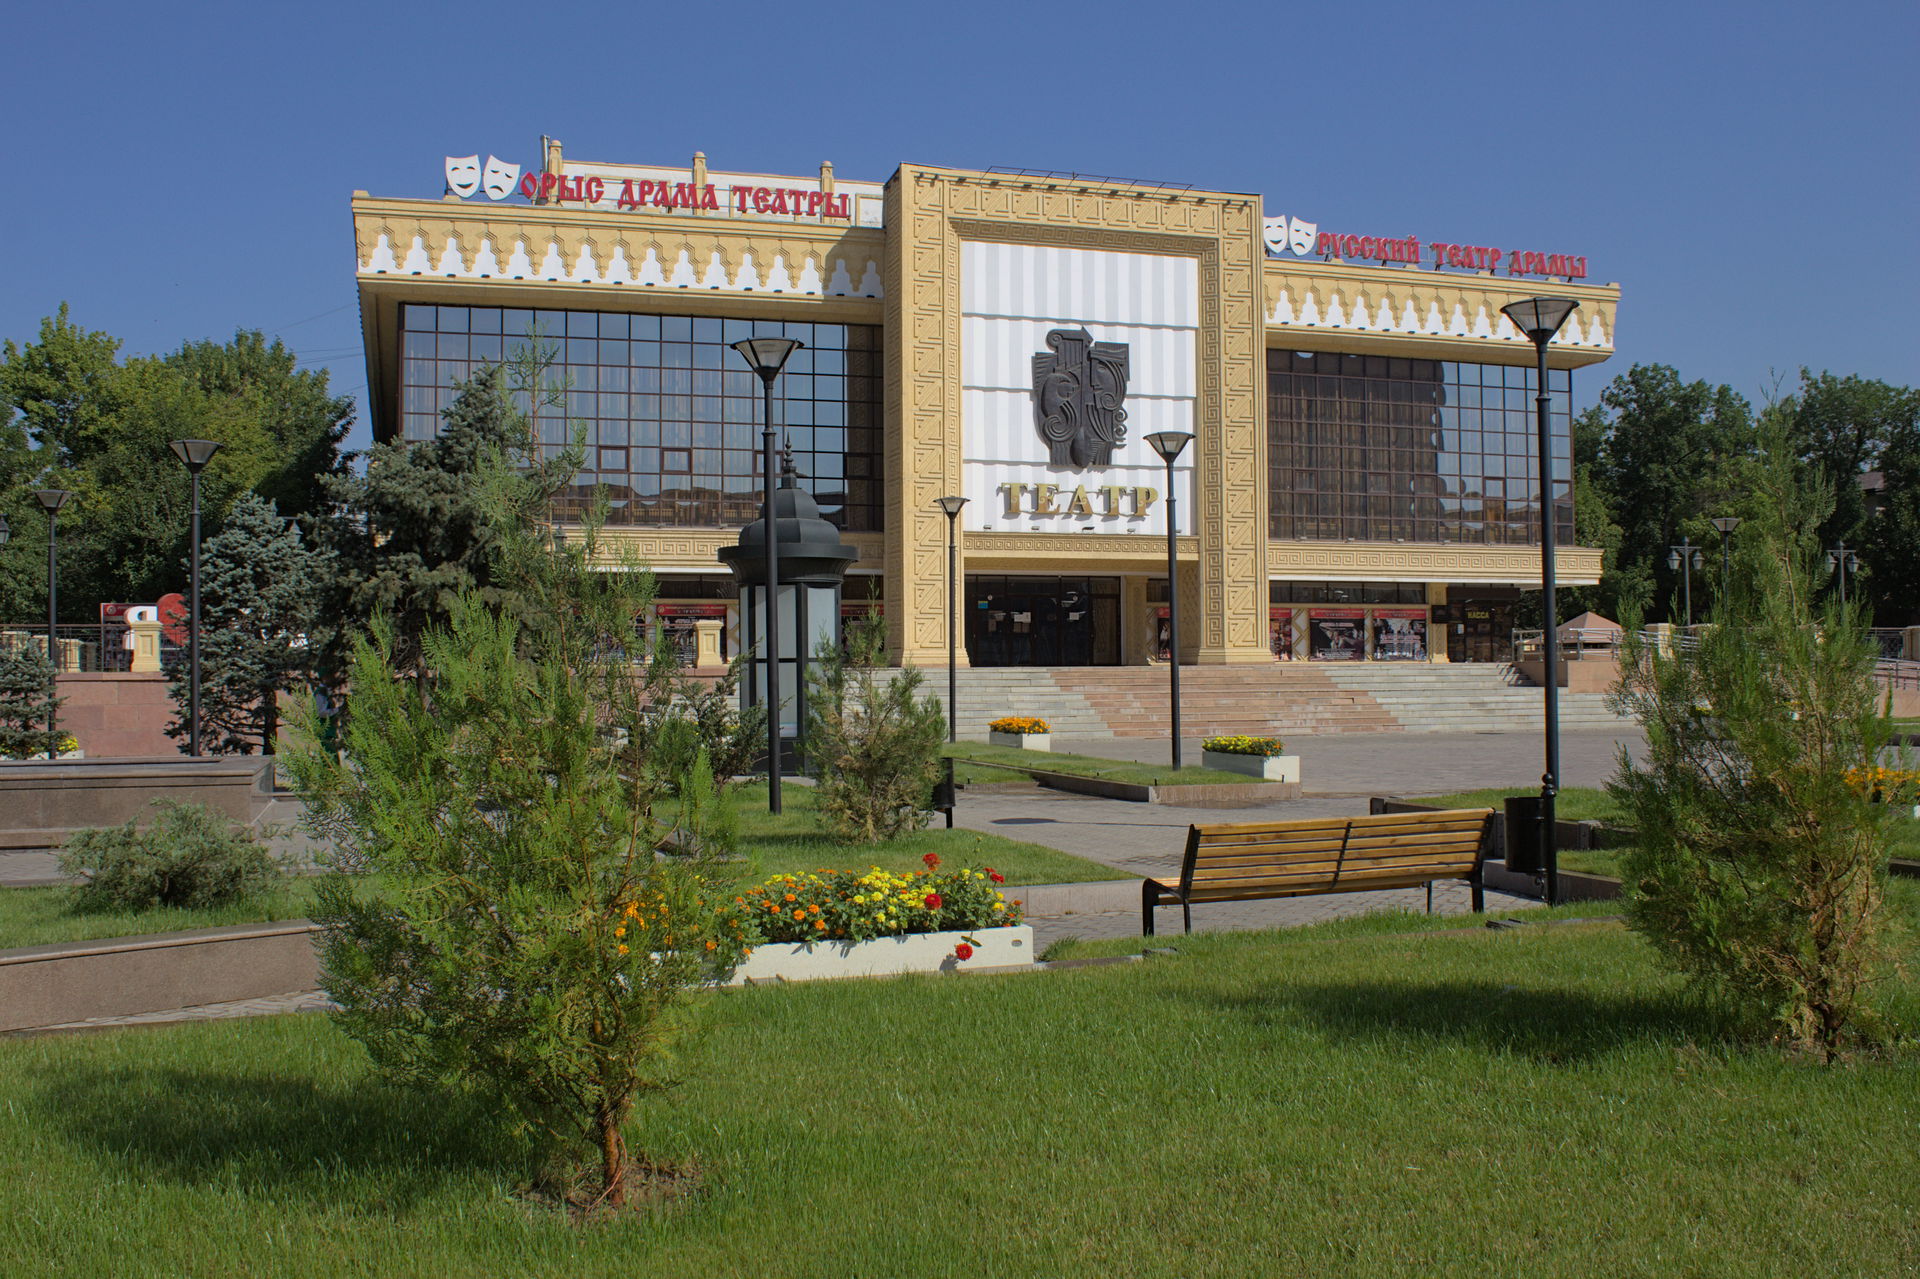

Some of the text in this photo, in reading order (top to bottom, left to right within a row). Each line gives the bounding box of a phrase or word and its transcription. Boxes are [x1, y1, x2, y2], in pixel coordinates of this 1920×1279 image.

[520, 172, 850, 219] ОРЫС ДРАМА ТЕАТРЫ
[1316, 231, 1588, 279] РУССКИЙ ТЕАТР ДРАМЫ
[1002, 483, 1158, 516] ТЕАТР
